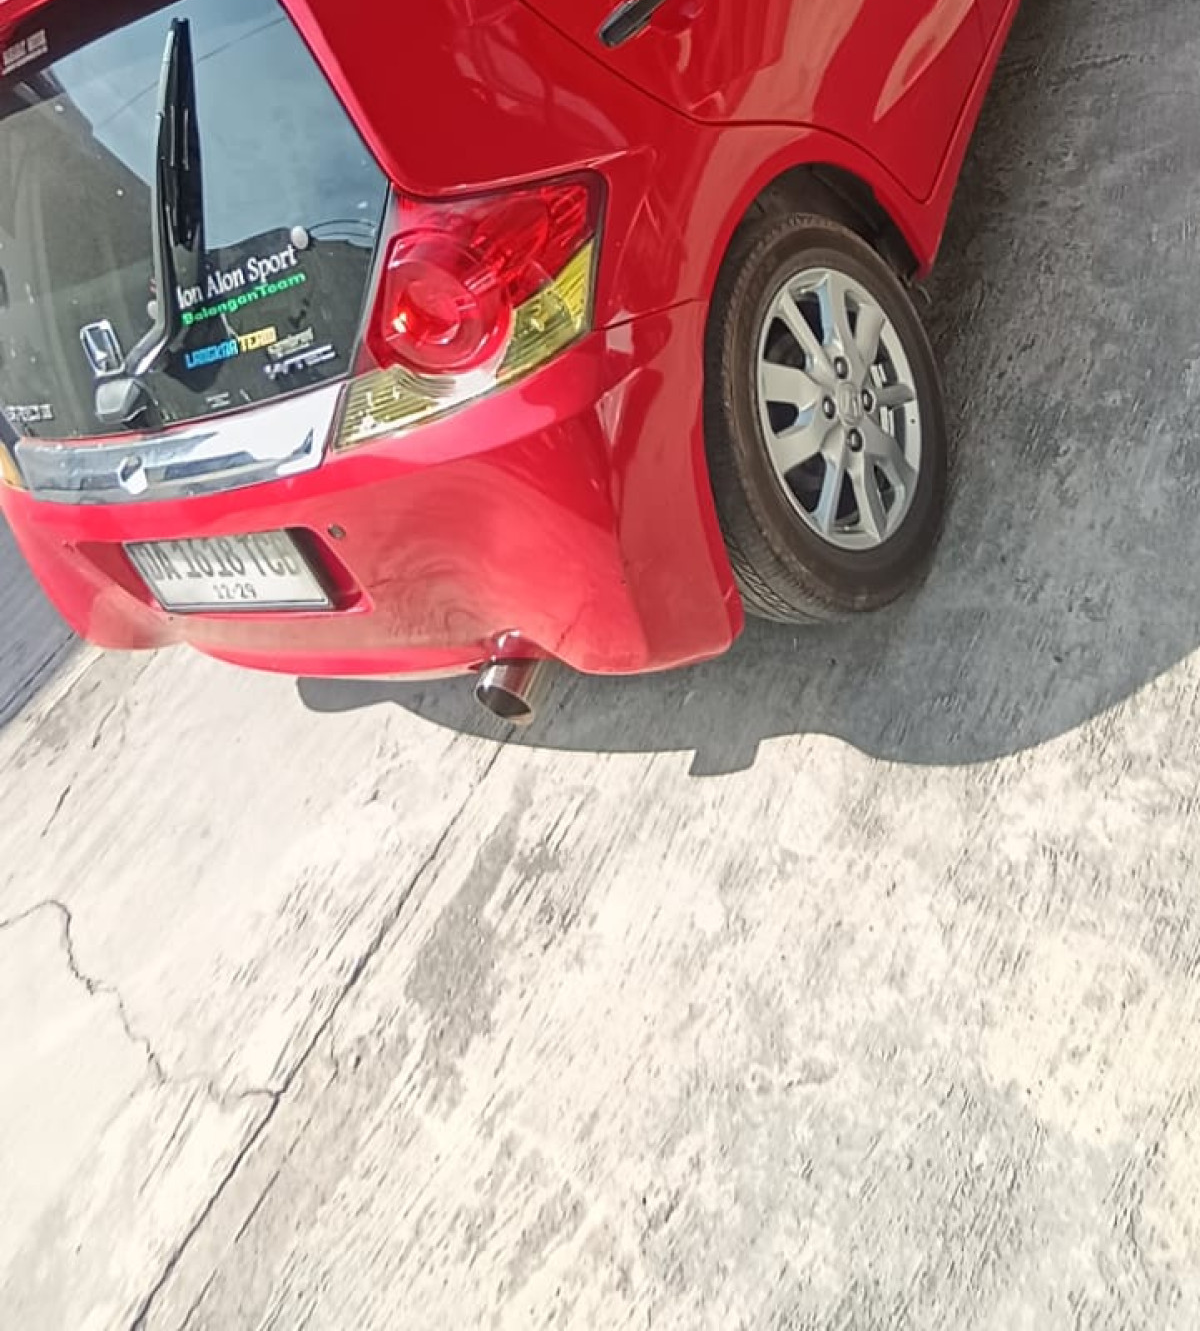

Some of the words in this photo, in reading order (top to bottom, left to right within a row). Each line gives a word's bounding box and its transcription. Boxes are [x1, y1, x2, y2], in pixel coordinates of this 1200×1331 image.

[207, 268, 246, 298] Alon
[247, 243, 298, 283] Sport
[173, 537, 246, 579] 1618
